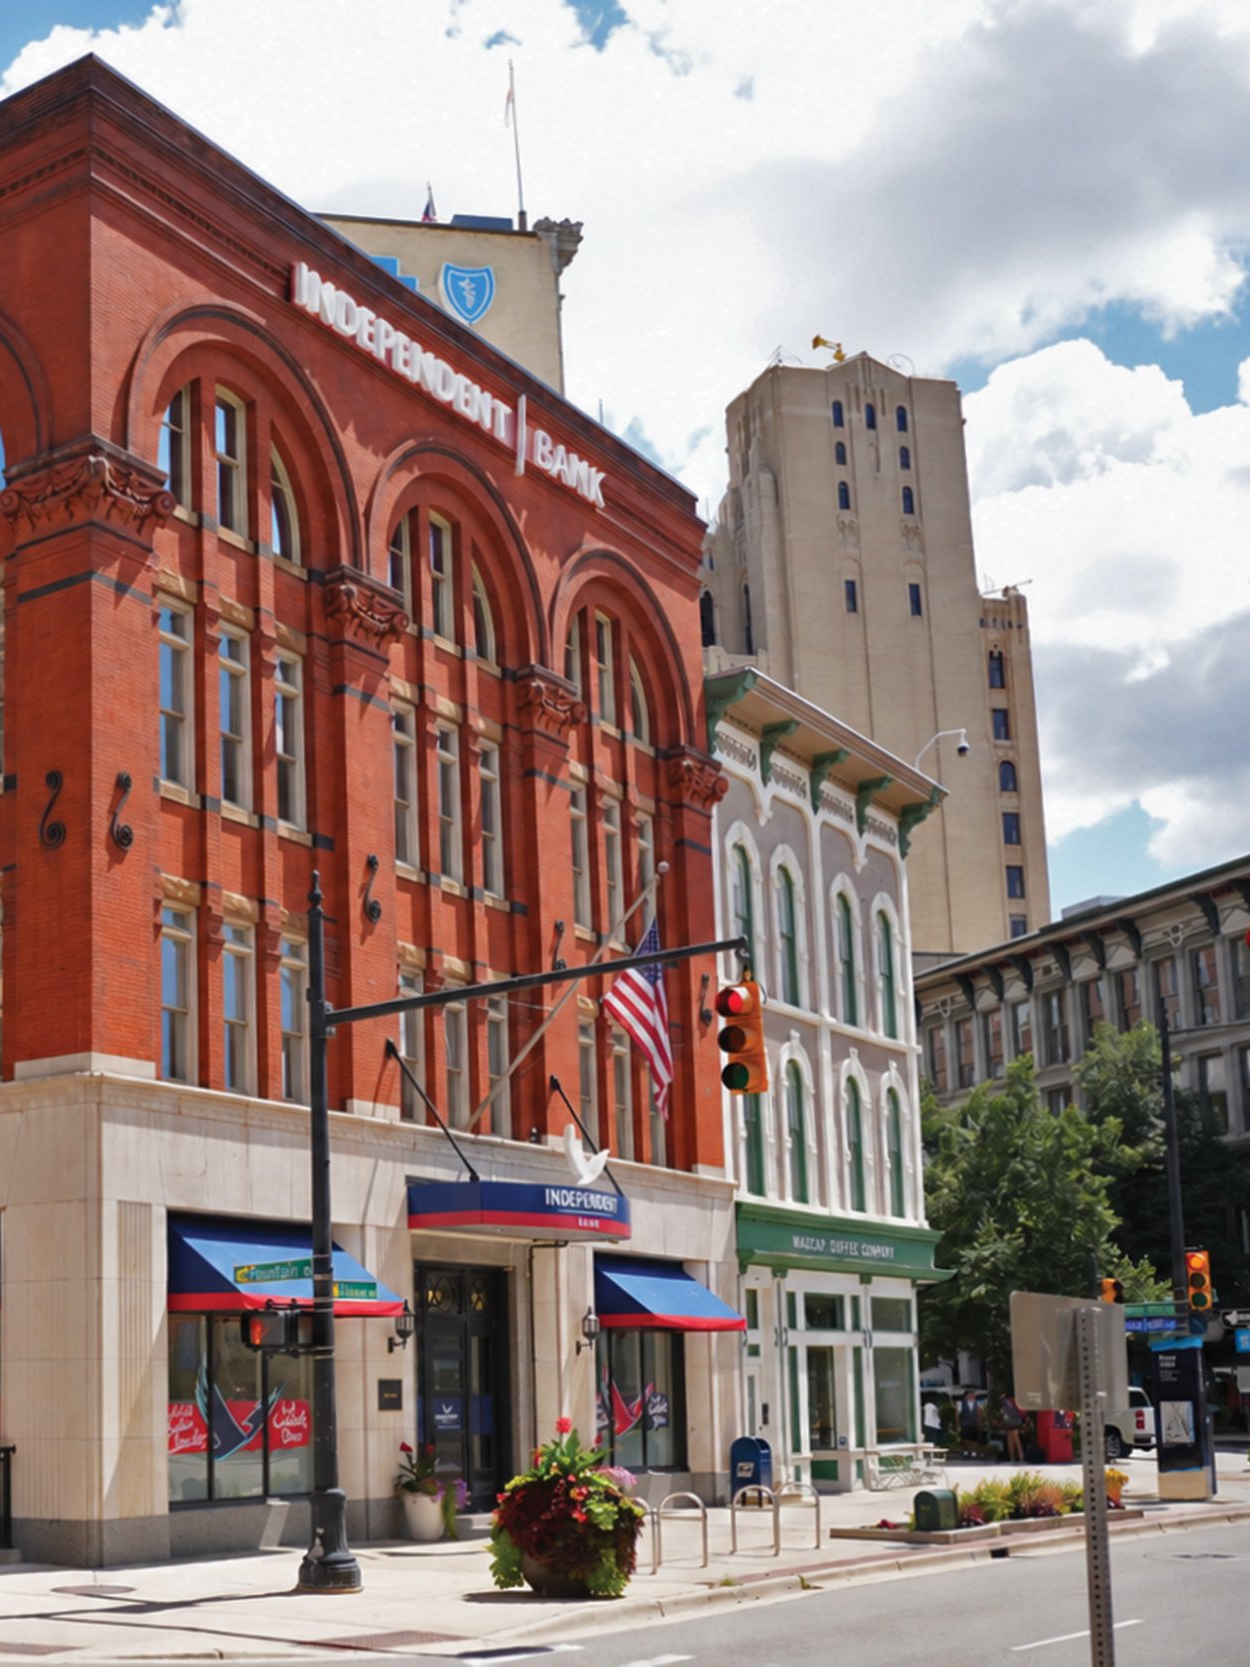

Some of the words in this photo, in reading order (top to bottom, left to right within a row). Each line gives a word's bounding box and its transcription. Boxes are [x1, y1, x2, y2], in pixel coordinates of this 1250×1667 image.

[294, 261, 512, 439] INDEPENDENT
[534, 429, 606, 508] BANK
[545, 1187, 618, 1214] INDEPENDENT
